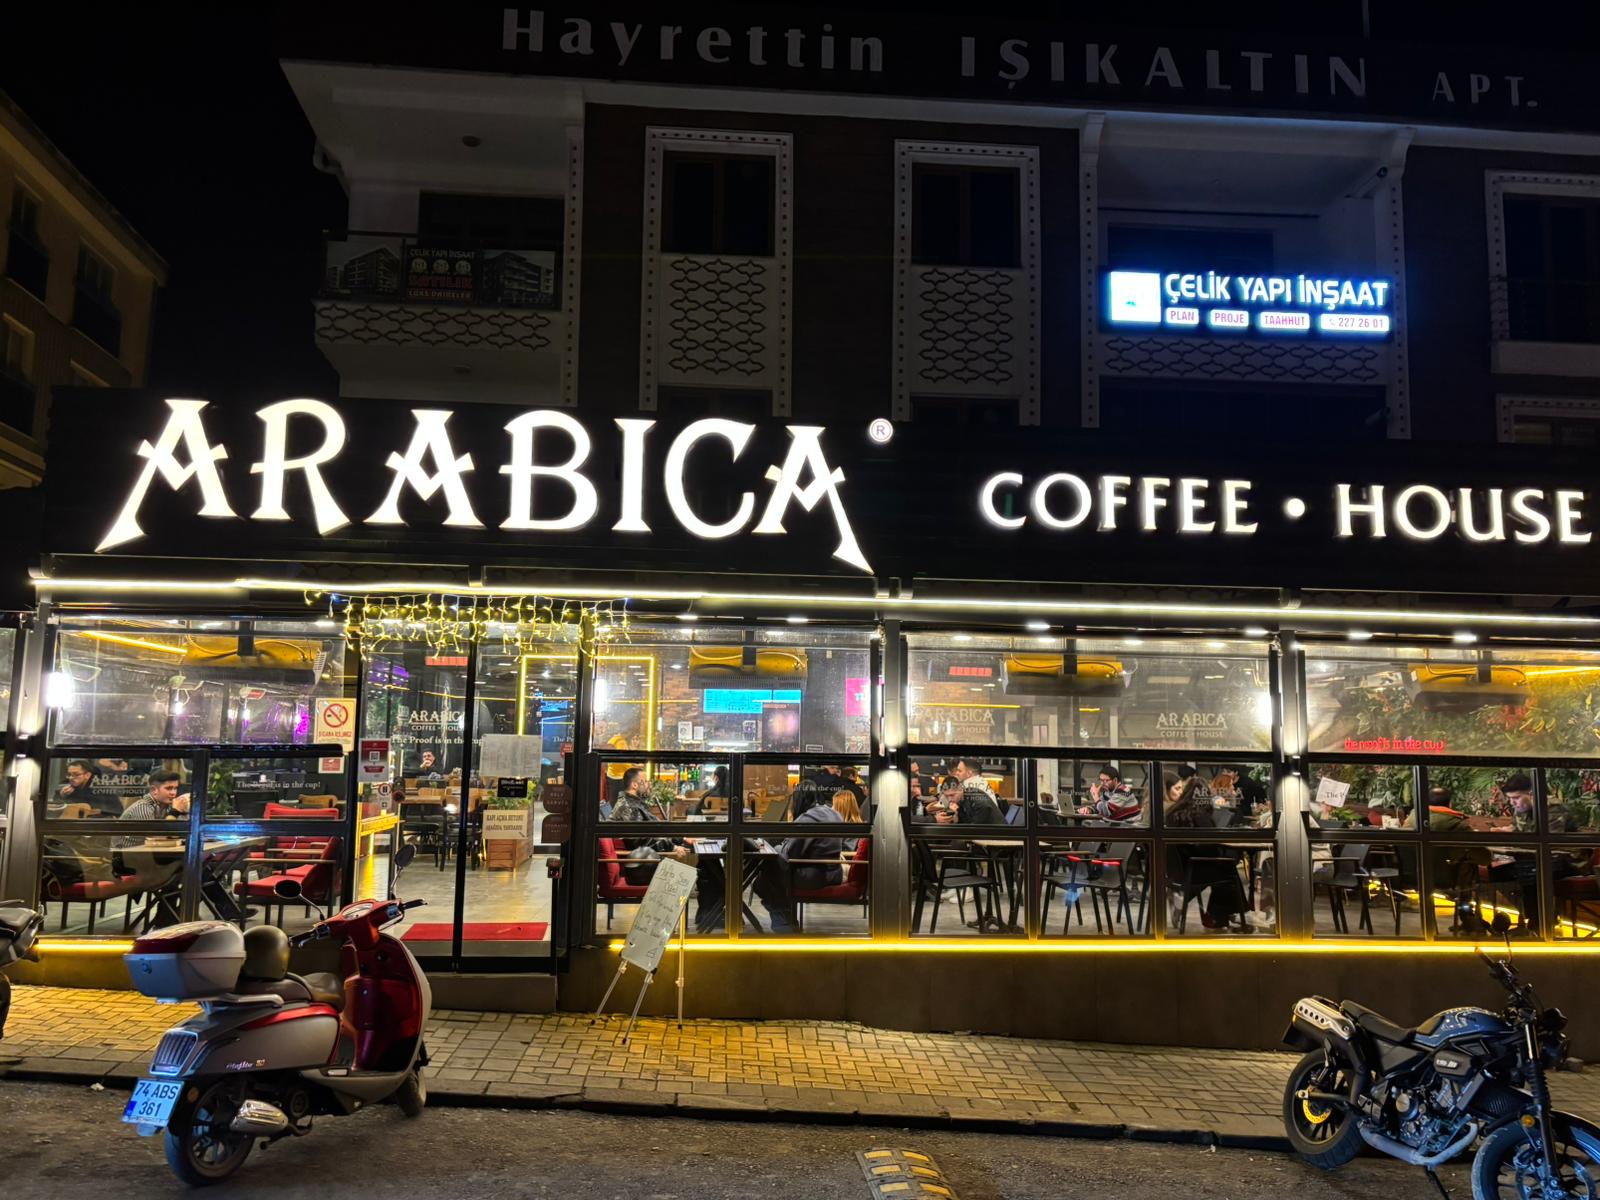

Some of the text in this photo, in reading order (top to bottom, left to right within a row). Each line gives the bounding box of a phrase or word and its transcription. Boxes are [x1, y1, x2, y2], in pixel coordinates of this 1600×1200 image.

[501, 8, 1541, 108] Hayrettin IŞIKALTIN APT.
[1164, 270, 1389, 311] ÇELİK YAPI İNŞAAT
[1170, 310, 1196, 322] PLAN
[1214, 312, 1245, 324] PROJE
[1338, 316, 1385, 329] 227 26 01
[95, 398, 873, 573] ARABICA
[980, 472, 1258, 534] COFFEE
[1337, 484, 1592, 543] HOUSE
[1156, 712, 1228, 729] ARABICA
[409, 735, 433, 744] Proof
[89, 773, 151, 788] ARABICA
[135, 1082, 178, 1101] 74 ABS
[138, 1101, 162, 1117] 361
